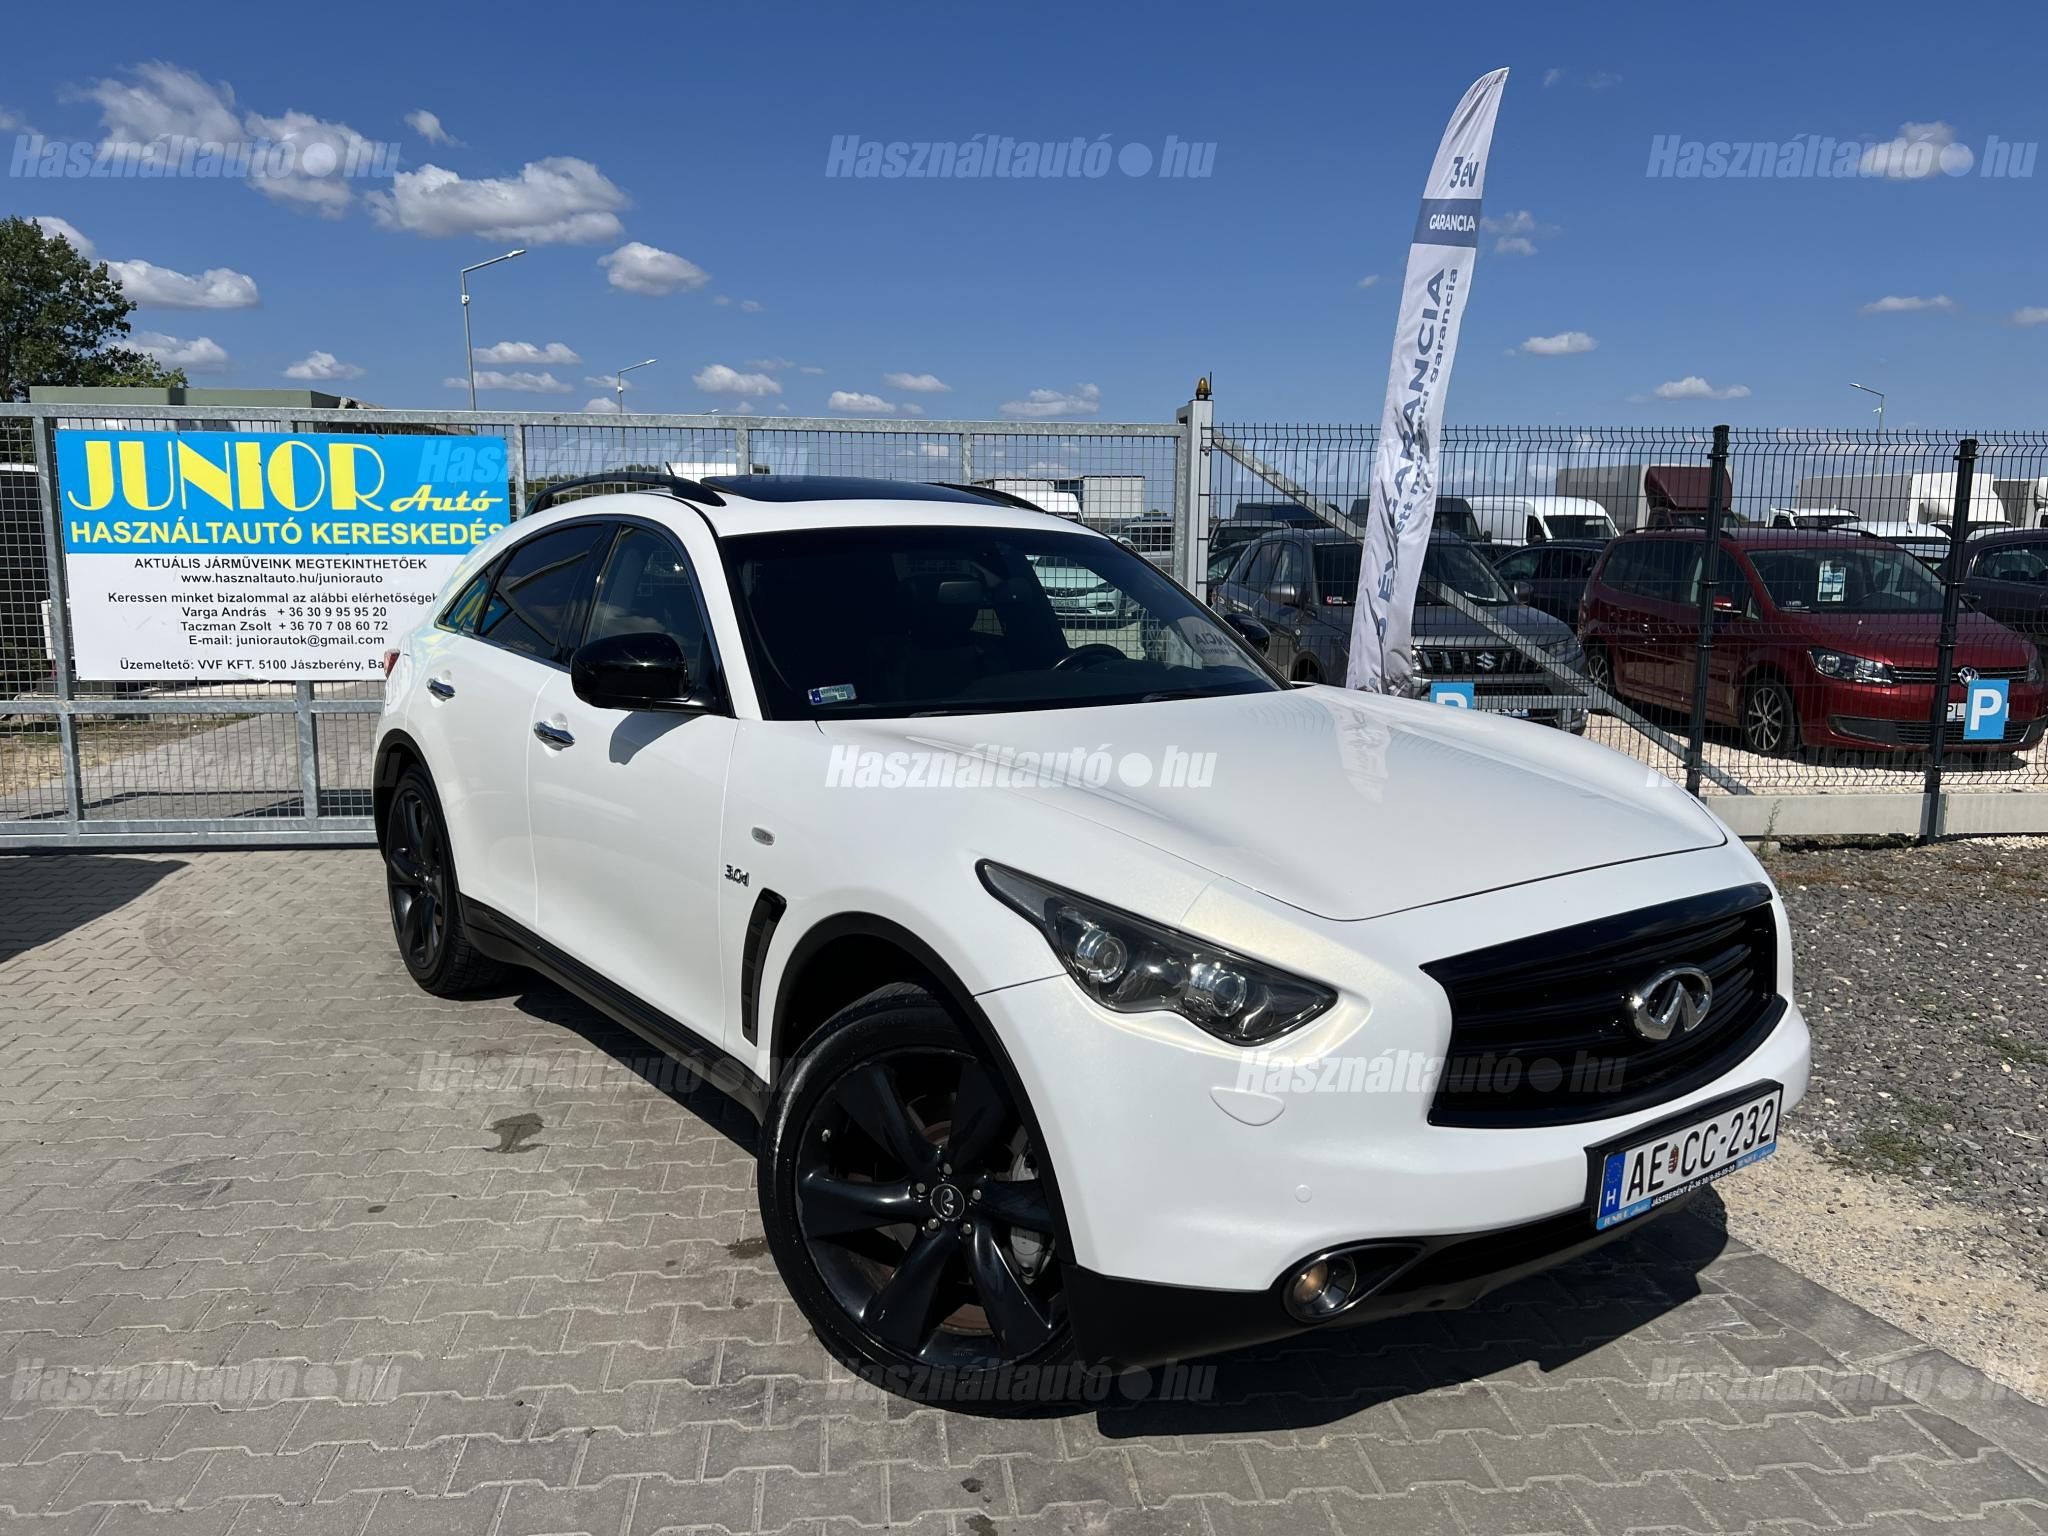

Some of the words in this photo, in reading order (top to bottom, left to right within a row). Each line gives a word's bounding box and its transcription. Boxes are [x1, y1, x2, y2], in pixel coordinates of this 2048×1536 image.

[1429, 213, 1476, 232] GARANCIA
[1429, 268, 1458, 384] garancia
[67, 439, 384, 512] JUNIOR
[390, 484, 504, 512] Autó
[70, 516, 303, 544] HASZNÁLTAUTÓ
[134, 556, 201, 569] AKTUÁLIS
[204, 556, 292, 569] JÁRMŰVEINK
[295, 557, 428, 569] MEGTEKINTHETŐEK
[181, 573, 383, 586] www.hasznaltauto.hu/juniorauto
[108, 592, 167, 603] Keressen
[171, 592, 214, 603] minket
[217, 592, 289, 603] bizalommal
[292, 595, 307, 603] az
[310, 592, 348, 603] alábbi
[181, 607, 218, 619] Varga
[221, 606, 267, 617] András
[289, 607, 304, 617] 36
[307, 607, 321, 617] 30
[325, 607, 332, 617] 9
[336, 607, 351, 617] 95
[354, 607, 369, 617] 95
[372, 607, 387, 617] 20
[180, 621, 236, 631] Taczman
[240, 621, 272, 631] Zsolt
[290, 621, 304, 631] 36
[308, 621, 322, 631] 70
[326, 621, 333, 631] 7
[337, 621, 351, 631] 08
[355, 621, 370, 631] 60
[374, 621, 389, 631] 72
[189, 635, 232, 645] E-mail:
[236, 635, 385, 647] juniorautok@gmail.com
[120, 657, 194, 670] Üzemeltető:
[198, 660, 223, 669] VVF
[227, 660, 254, 669] KFT.
[259, 660, 287, 669] 5100
[290, 659, 364, 671] Jászberény,
[1970, 688, 2002, 731] P
[1681, 1098, 1775, 1177] CC-232
[1605, 1188, 1616, 1207] H
